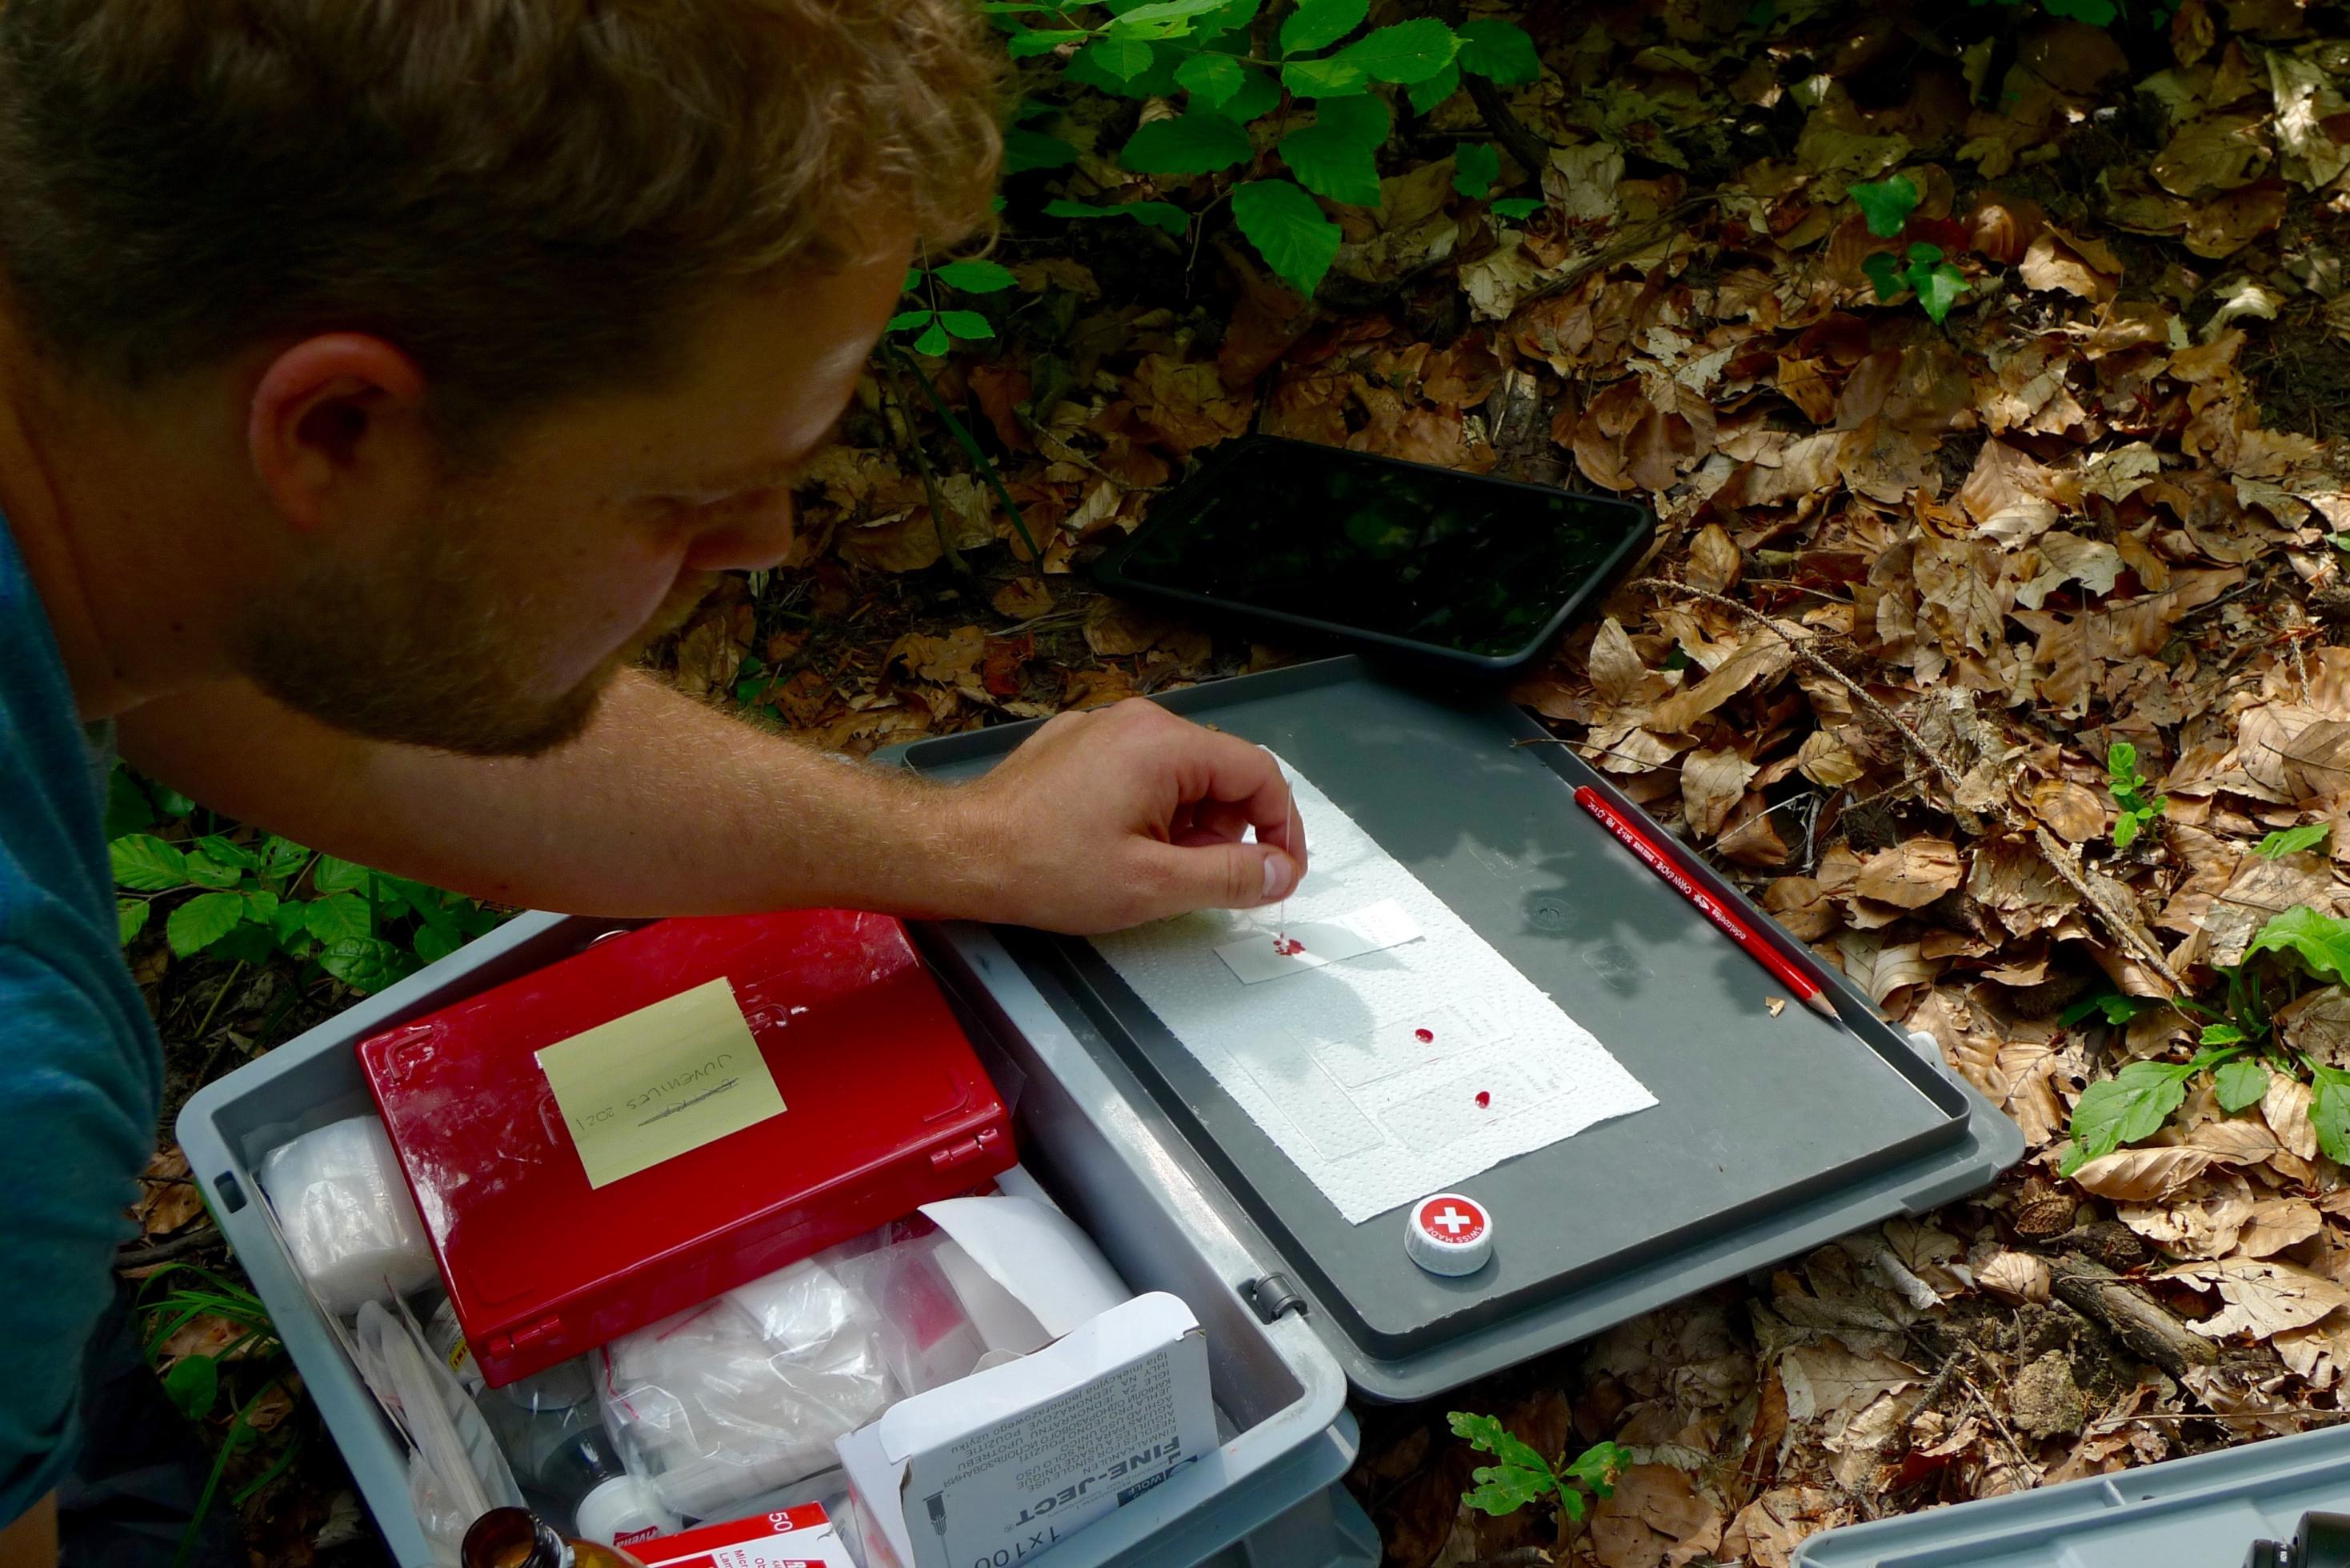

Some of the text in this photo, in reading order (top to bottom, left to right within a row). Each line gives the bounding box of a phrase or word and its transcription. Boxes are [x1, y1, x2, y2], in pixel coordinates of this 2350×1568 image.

[1672, 875, 1691, 894] CARAN
[1711, 908, 1746, 939] edelweiss
[576, 1054, 732, 1131] JUVENILES 2021
[1426, 1226, 1483, 1243] SWISS MADE
[1086, 1362, 1142, 1394] iniekcyjna
[1121, 1374, 1136, 1386] NA
[1143, 1359, 1168, 1376] IHLY
[1108, 1402, 1133, 1419] PRO
[1136, 1385, 1171, 1406] JEHLA
[958, 1369, 1169, 1471] IGLE ZA JEDNOKRATNU UPOTREBU
[993, 1390, 1082, 1434] jednorazowego
[1040, 1399, 1125, 1444] ОДНОРАЗОВОГО
[1060, 1394, 1171, 1452] AGHI AD USO UNICO
[1068, 1415, 1106, 1439] JEDNO
[1115, 1408, 1174, 1442] AIGUILLES
[1015, 1401, 1173, 1481] AGUJAS PARA UN SOLO USO
[1027, 1416, 1175, 1493] NEEDLES FOR SINGLE USE
[1064, 1442, 1103, 1466] USAGE
[1083, 1425, 1176, 1474] EINMALKANÜLEN
[943, 1440, 1038, 1487] ИСПОЛЬЗОВАНИЯ
[1016, 1463, 1061, 1490] UNIQUE
[1128, 1474, 1160, 1495] WOLF
[769, 1511, 793, 1532] 50
